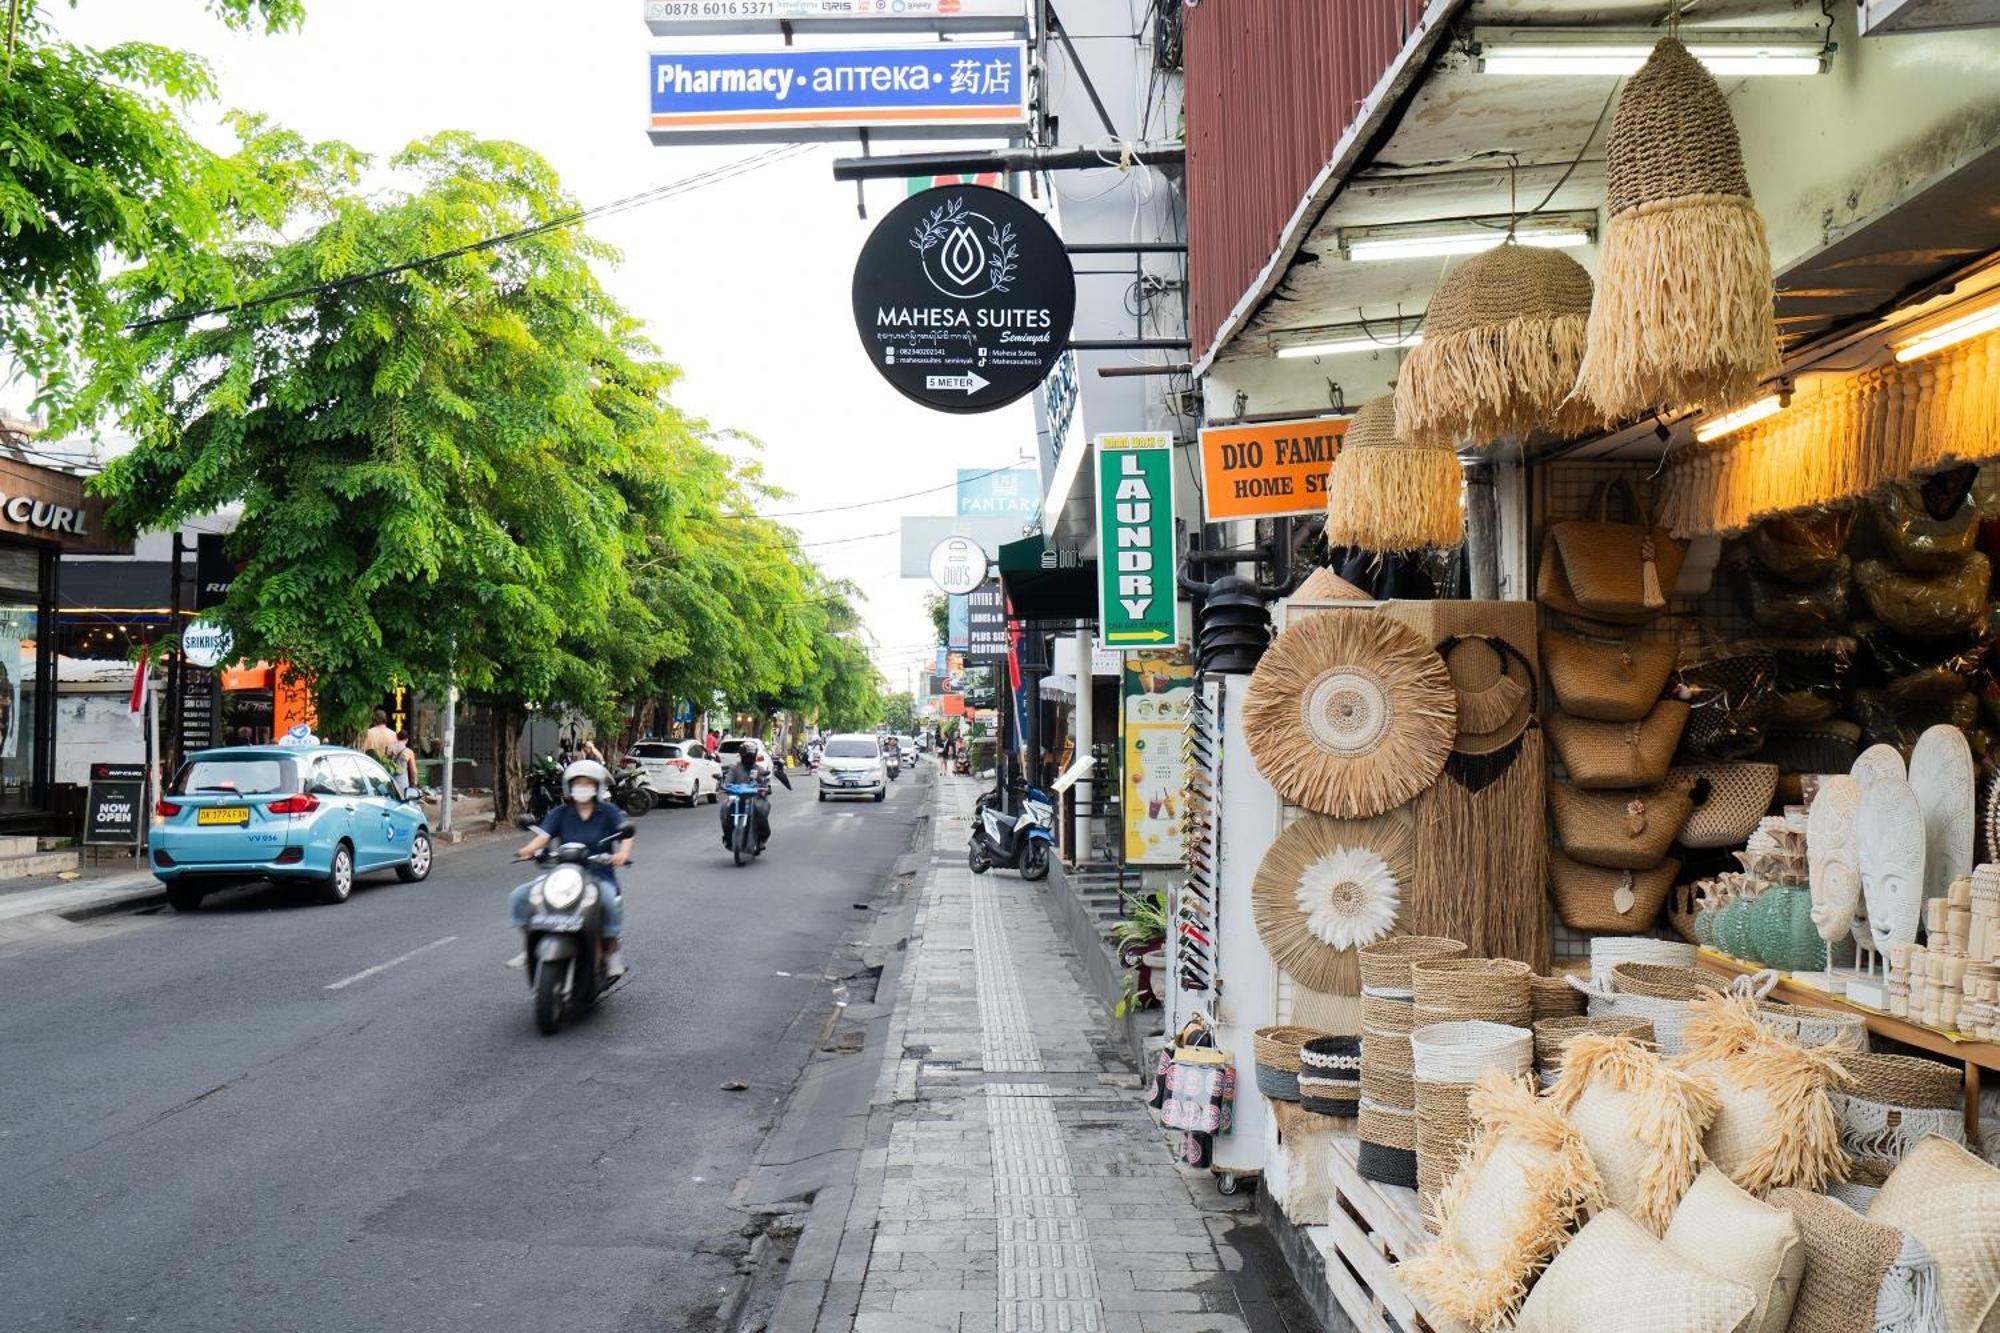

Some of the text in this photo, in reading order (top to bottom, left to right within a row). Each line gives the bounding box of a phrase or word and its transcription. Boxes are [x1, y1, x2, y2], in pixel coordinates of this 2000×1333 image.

[665, 3, 699, 16] 0878
[703, 3, 737, 15] 6016
[742, 2, 774, 15] 5371
[657, 59, 1012, 100] Pharmacy аптека 药店
[877, 307, 1052, 328] MAHESA SUITES
[999, 330, 1051, 346] Seminyak
[929, 378, 974, 387] 5 METER
[1221, 440, 1264, 471] DIO
[1235, 472, 1332, 499] HOME ST
[7, 496, 89, 536] CURL
[1115, 454, 1154, 620] LAUNDRY
[96, 812, 132, 822] OPEN
[99, 803, 131, 813] NOW
